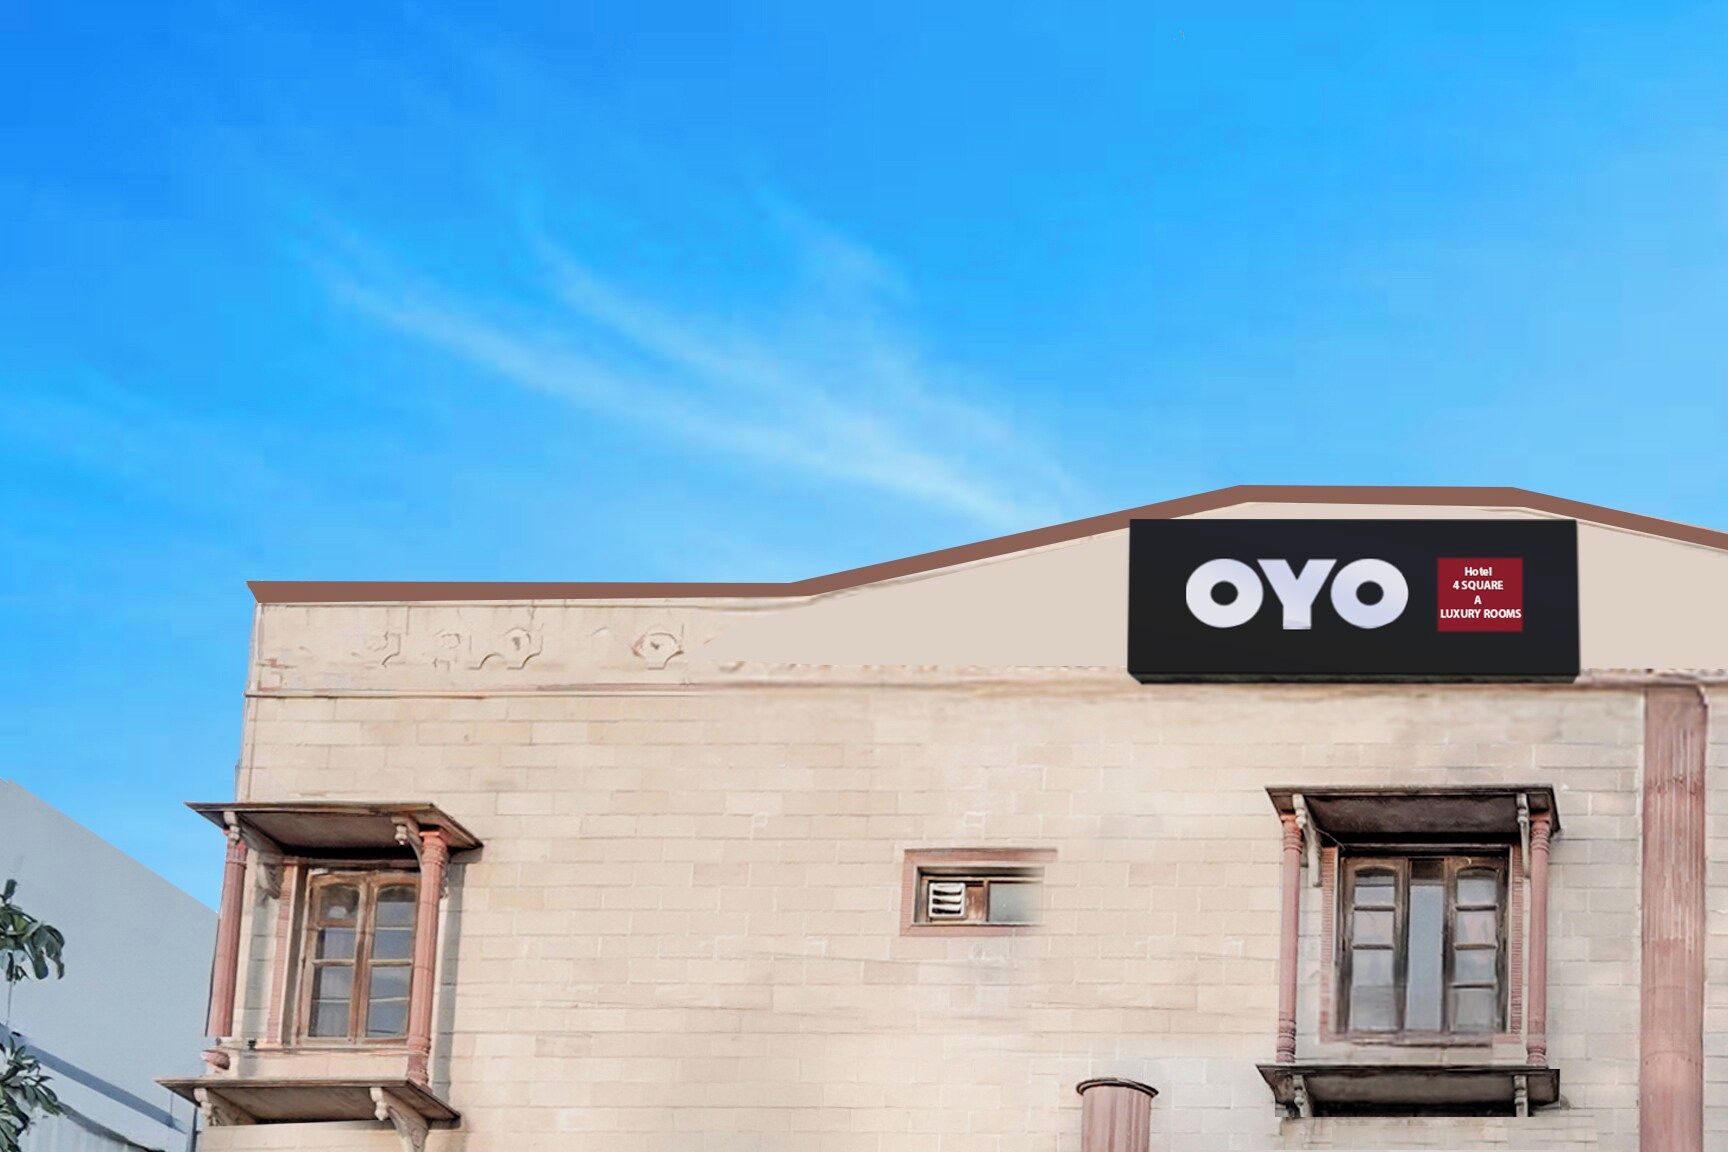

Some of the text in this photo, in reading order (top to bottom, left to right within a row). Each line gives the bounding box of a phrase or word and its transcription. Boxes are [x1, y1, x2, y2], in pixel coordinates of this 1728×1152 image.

[1464, 567, 1493, 577] Hotel
[1452, 580, 1504, 591] 4 SQUARE
[1186, 558, 1409, 630] OYO
[1473, 595, 1482, 605] A
[1440, 609, 1522, 619] LUXURY ROOMS
